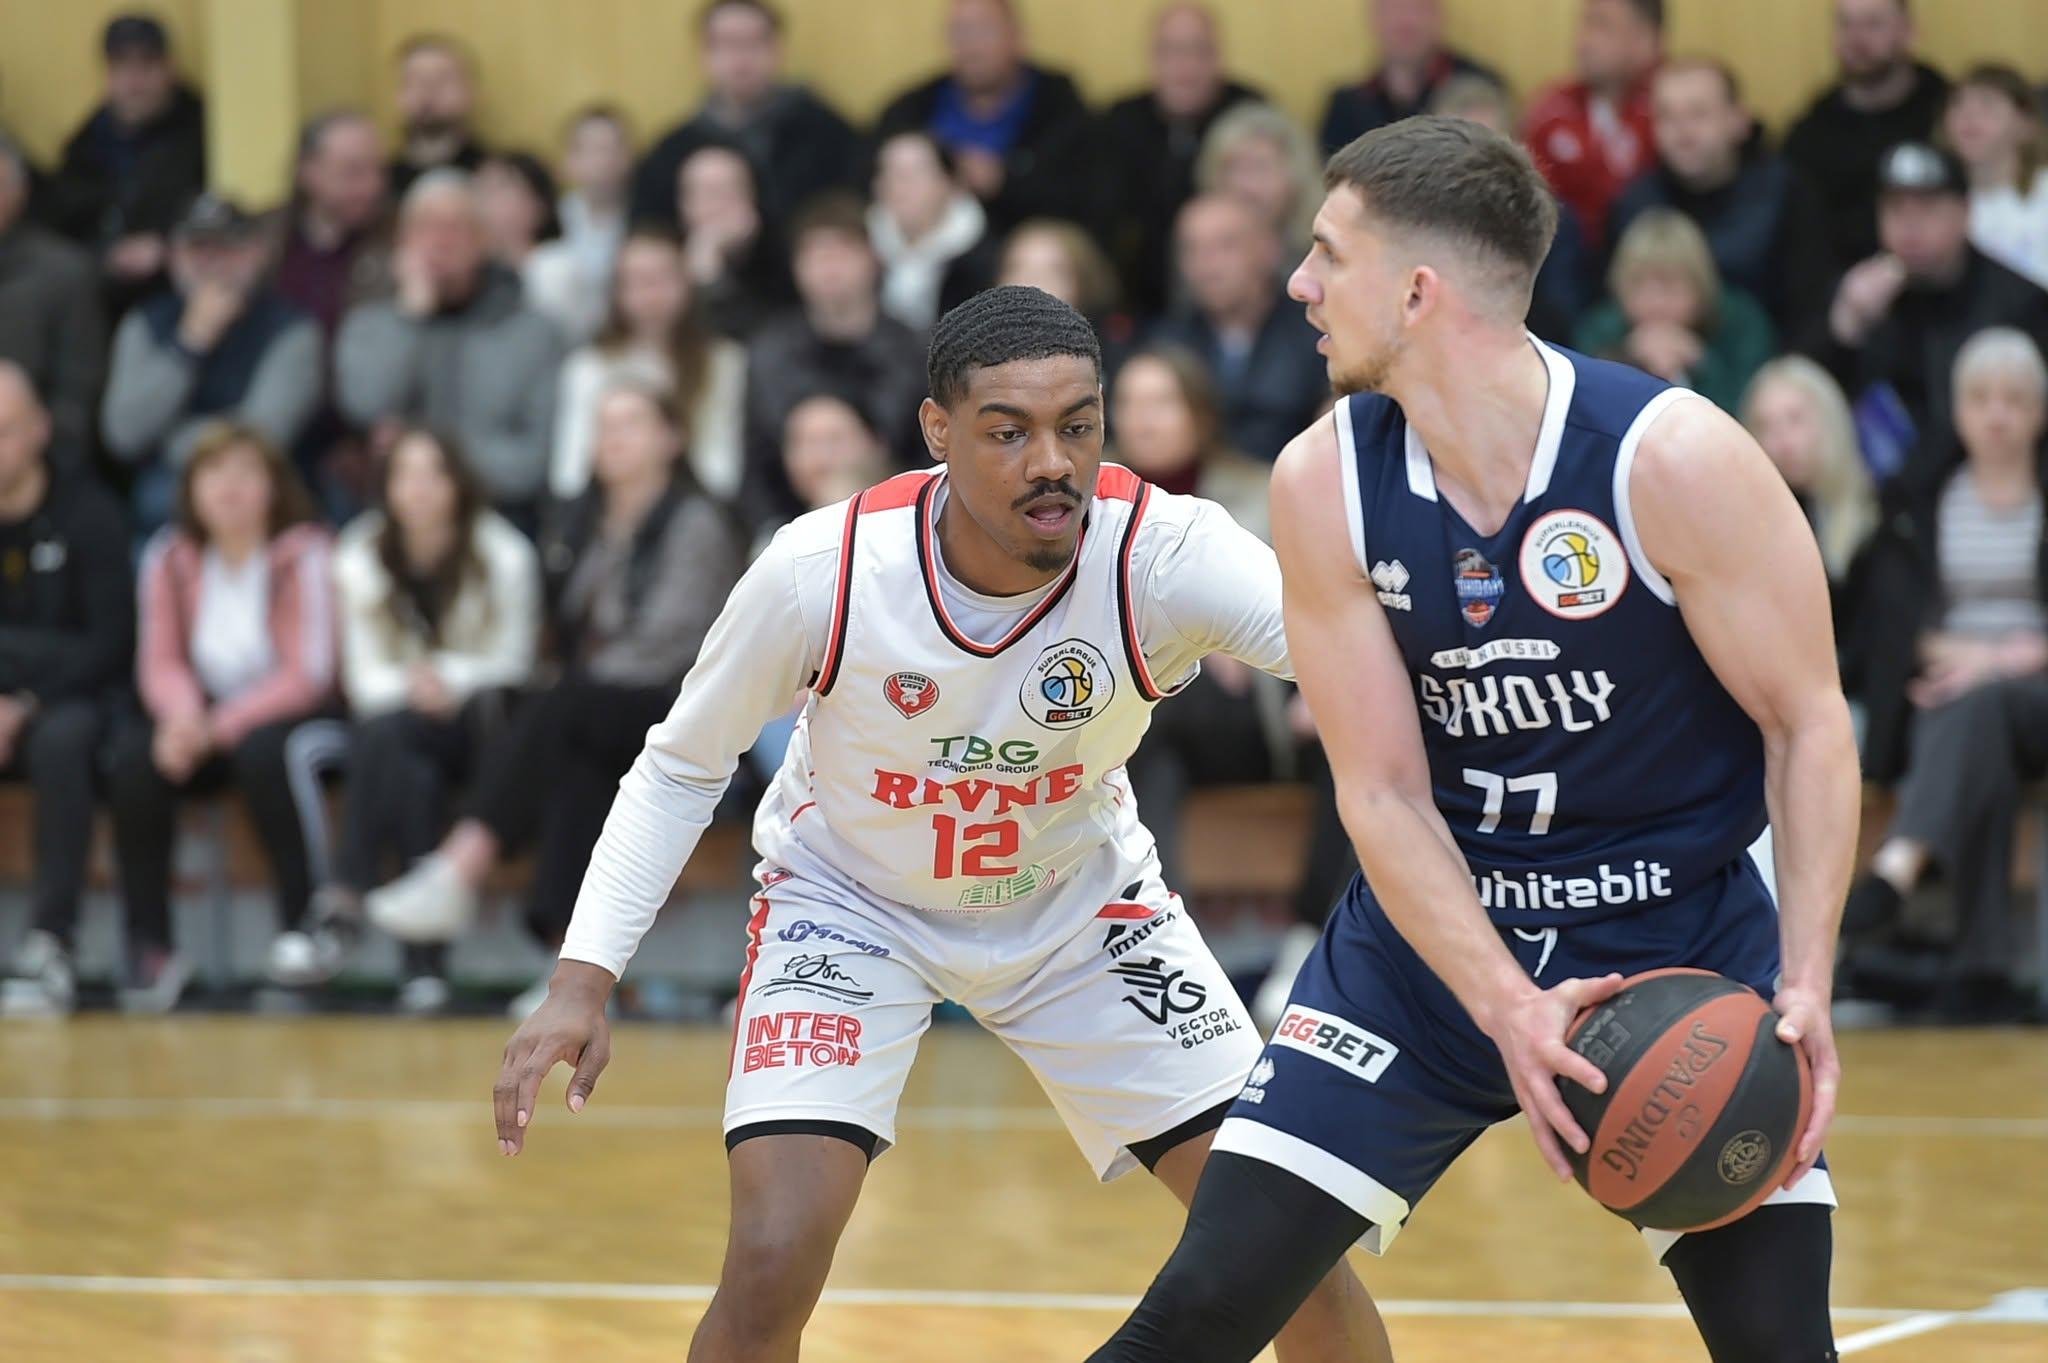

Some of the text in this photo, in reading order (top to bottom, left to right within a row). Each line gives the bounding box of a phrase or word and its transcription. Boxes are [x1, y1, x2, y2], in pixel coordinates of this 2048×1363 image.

[1037, 647, 1097, 673] SUPERLEAGUE
[930, 735, 1039, 765] TBG
[996, 763, 1039, 774] GROUP
[870, 764, 1084, 815] RIVNE
[1462, 767, 1559, 835] 77
[931, 813, 1019, 879] 12
[746, 1012, 862, 1049] INTER
[1166, 1007, 1230, 1039] VECTOR
[1181, 1019, 1242, 1049] GLOBAL
[743, 1041, 861, 1074] BETON
[1601, 1022, 1728, 1182] SPALDING
